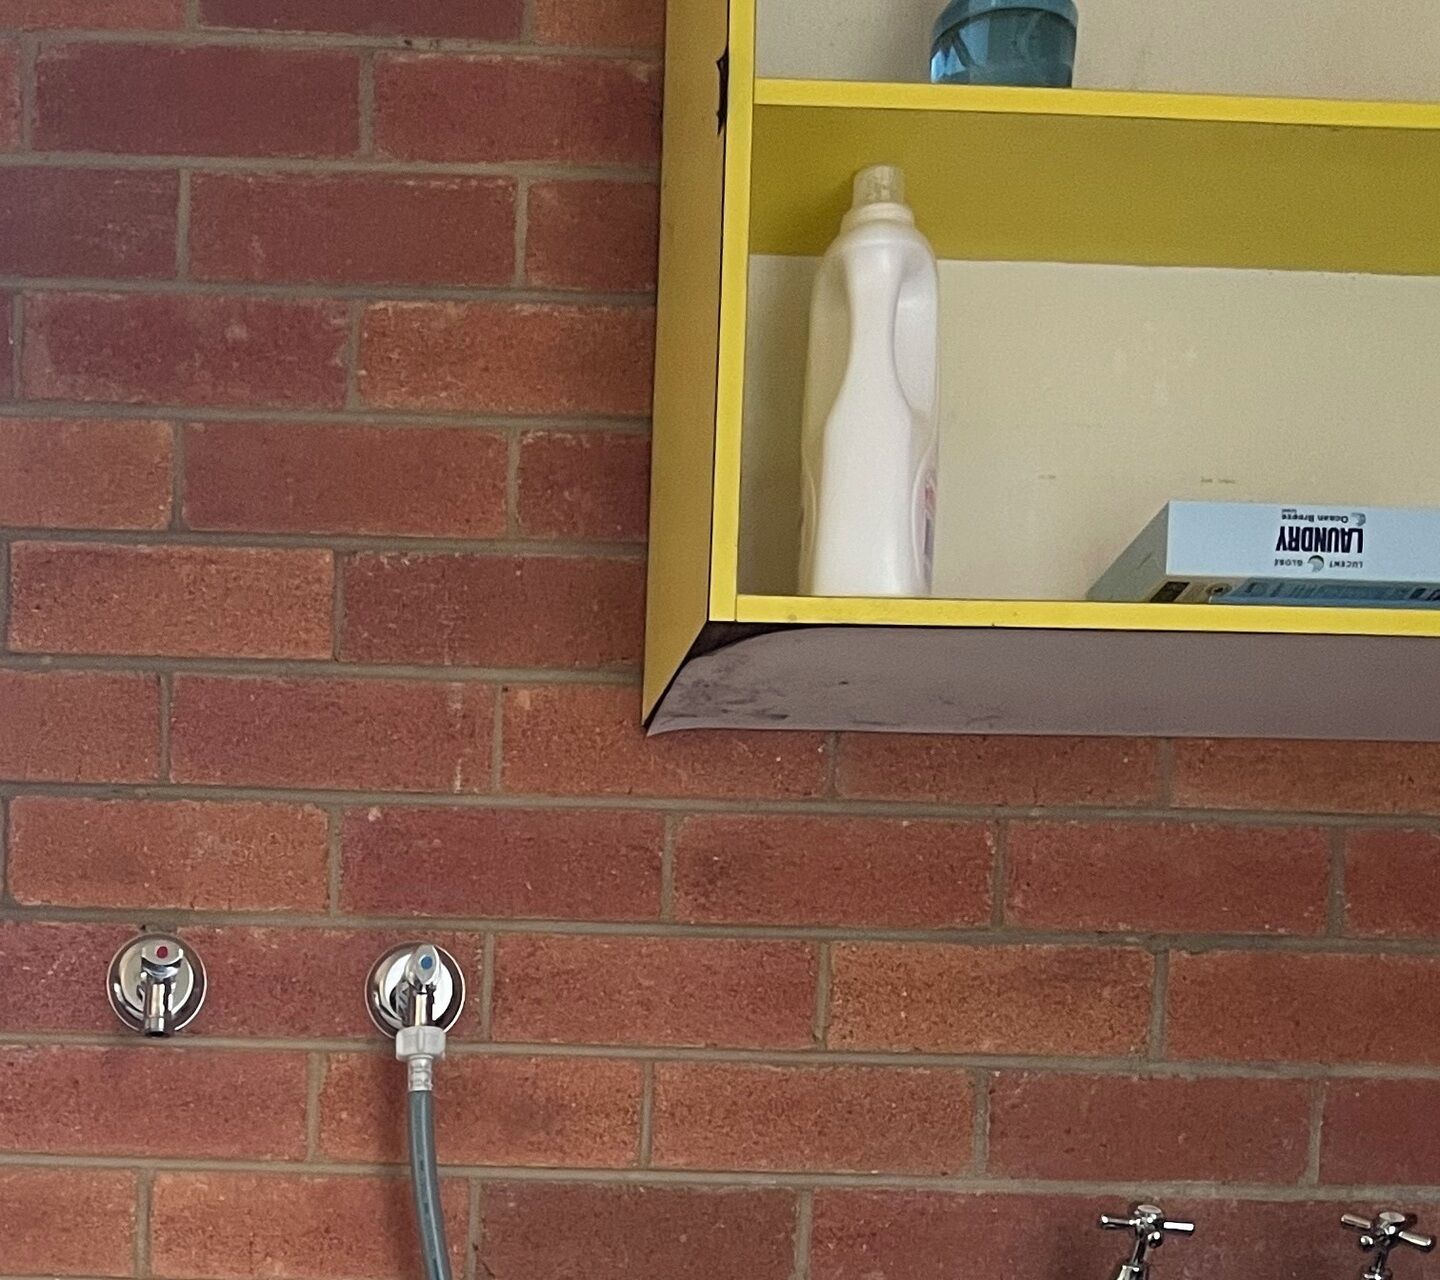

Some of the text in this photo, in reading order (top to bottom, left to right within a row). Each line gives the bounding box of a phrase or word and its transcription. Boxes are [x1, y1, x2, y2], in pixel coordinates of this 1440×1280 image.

[1317, 515, 1349, 524] Ocean
[1275, 526, 1364, 554] LAUNDRY
[1329, 560, 1363, 568] LUCENT
